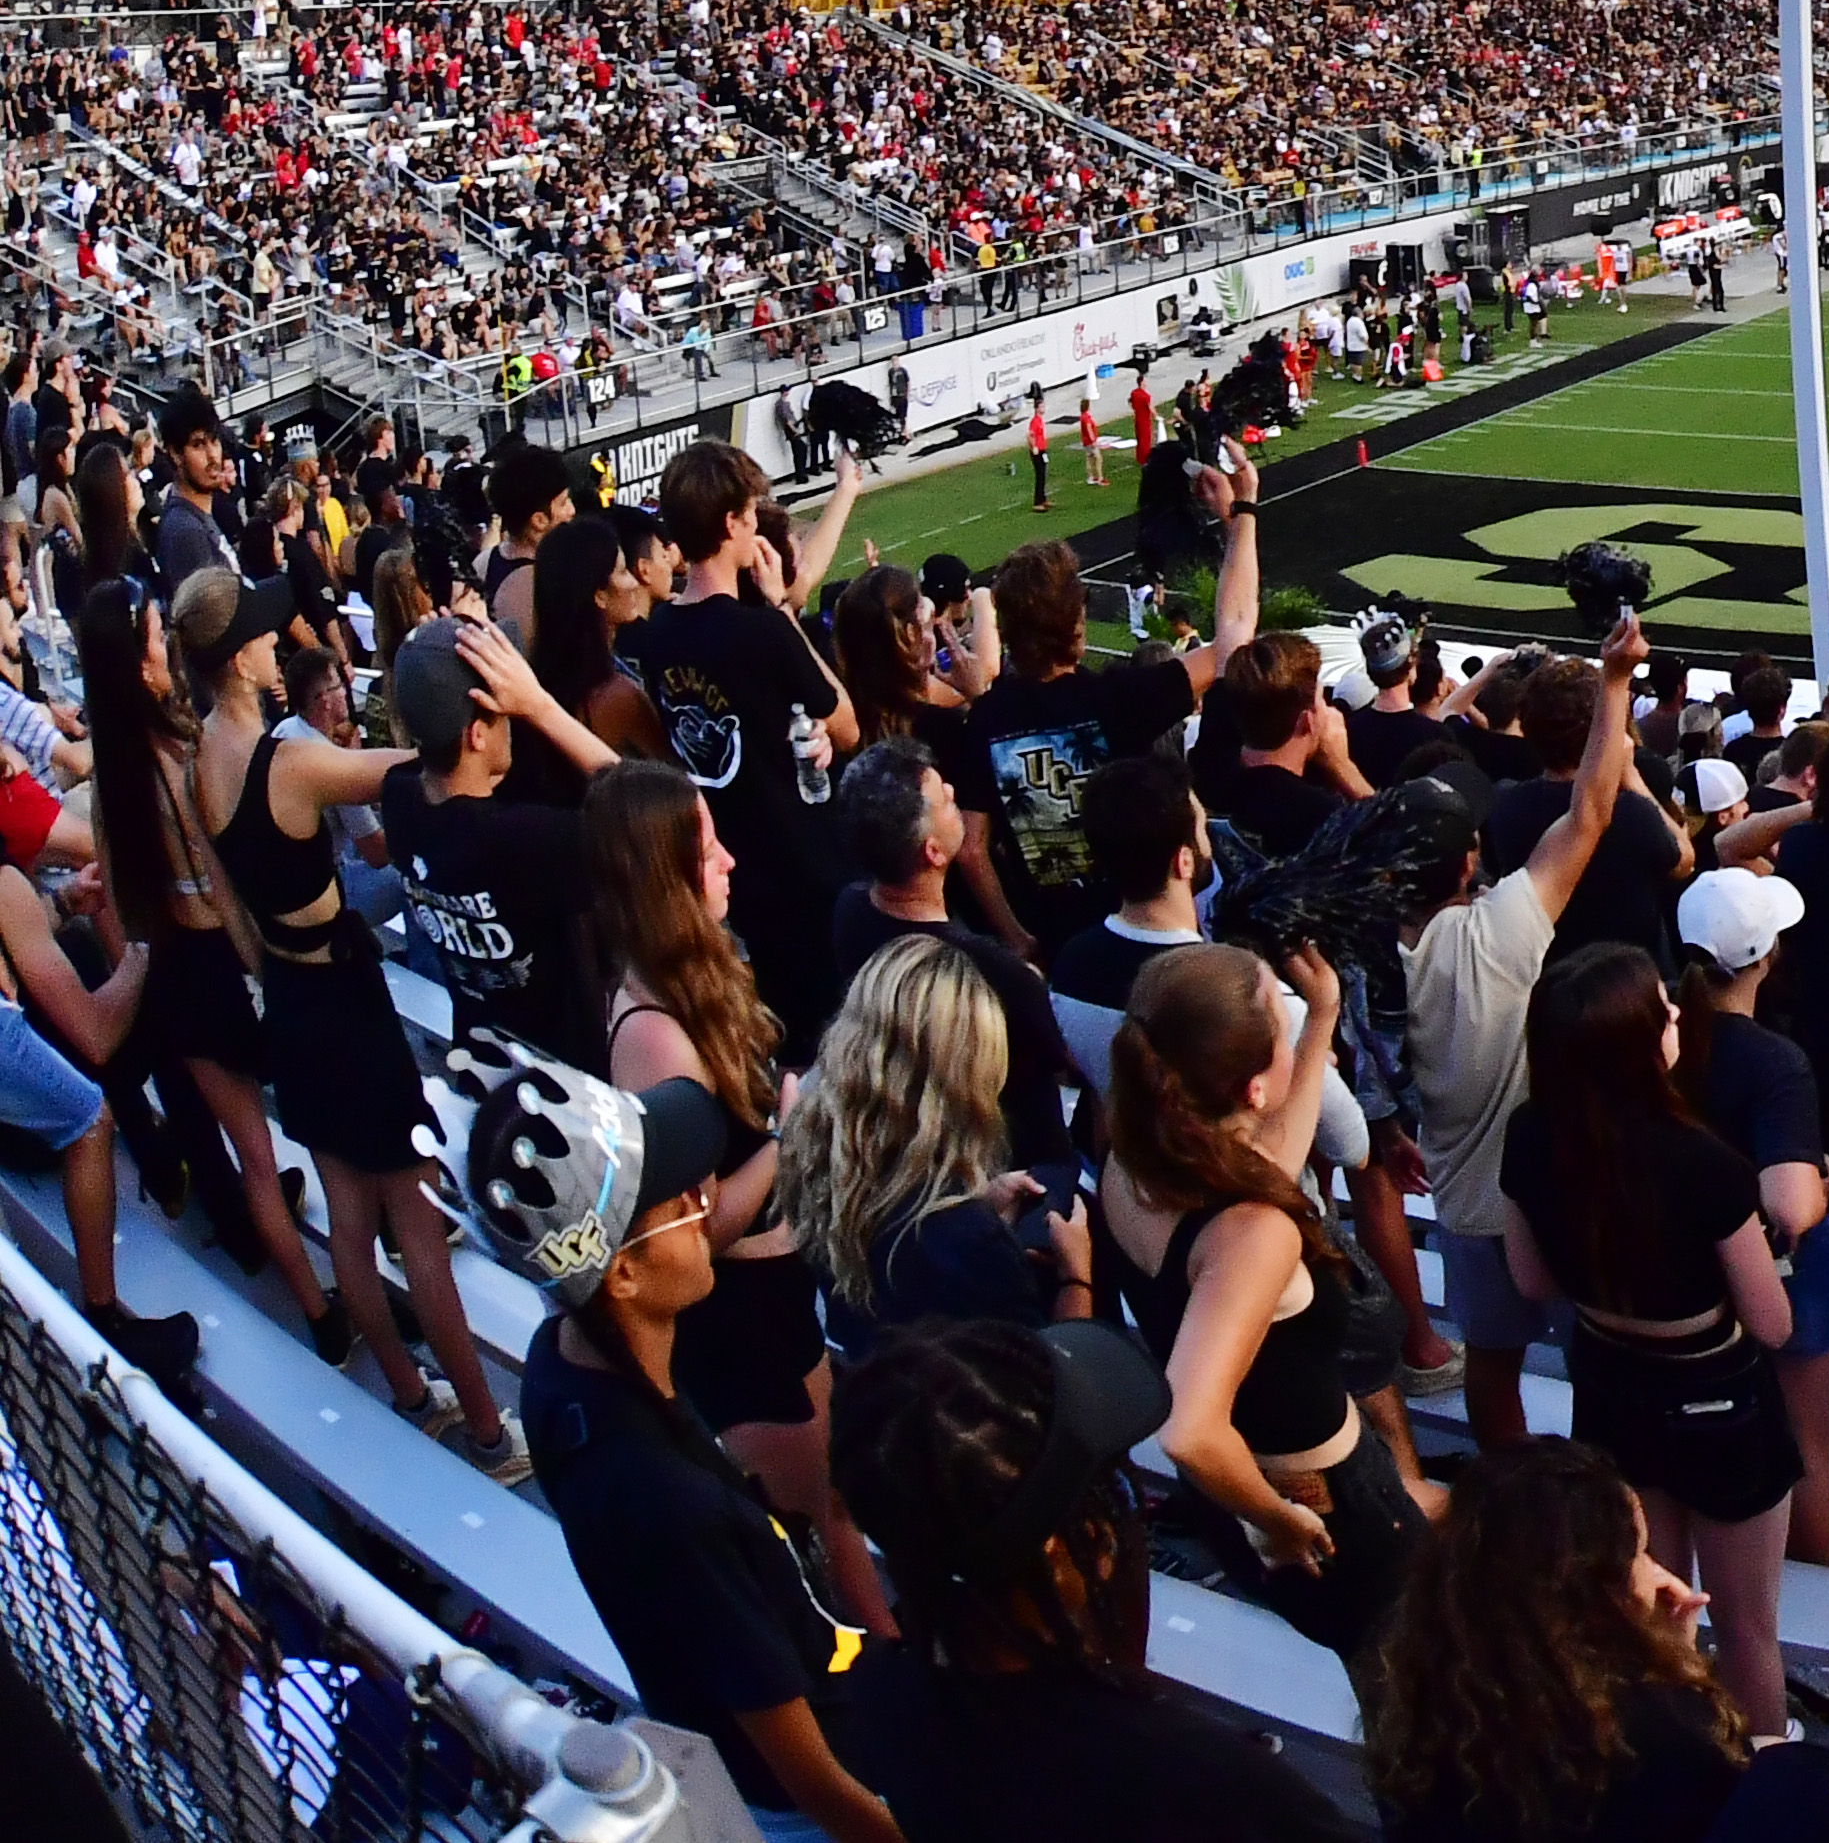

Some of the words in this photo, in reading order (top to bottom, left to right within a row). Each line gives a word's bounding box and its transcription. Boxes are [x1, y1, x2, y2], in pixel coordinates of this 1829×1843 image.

[588, 374, 616, 403] 124
[1014, 744, 1093, 821] UCF
[526, 1209, 612, 1279] UCF
